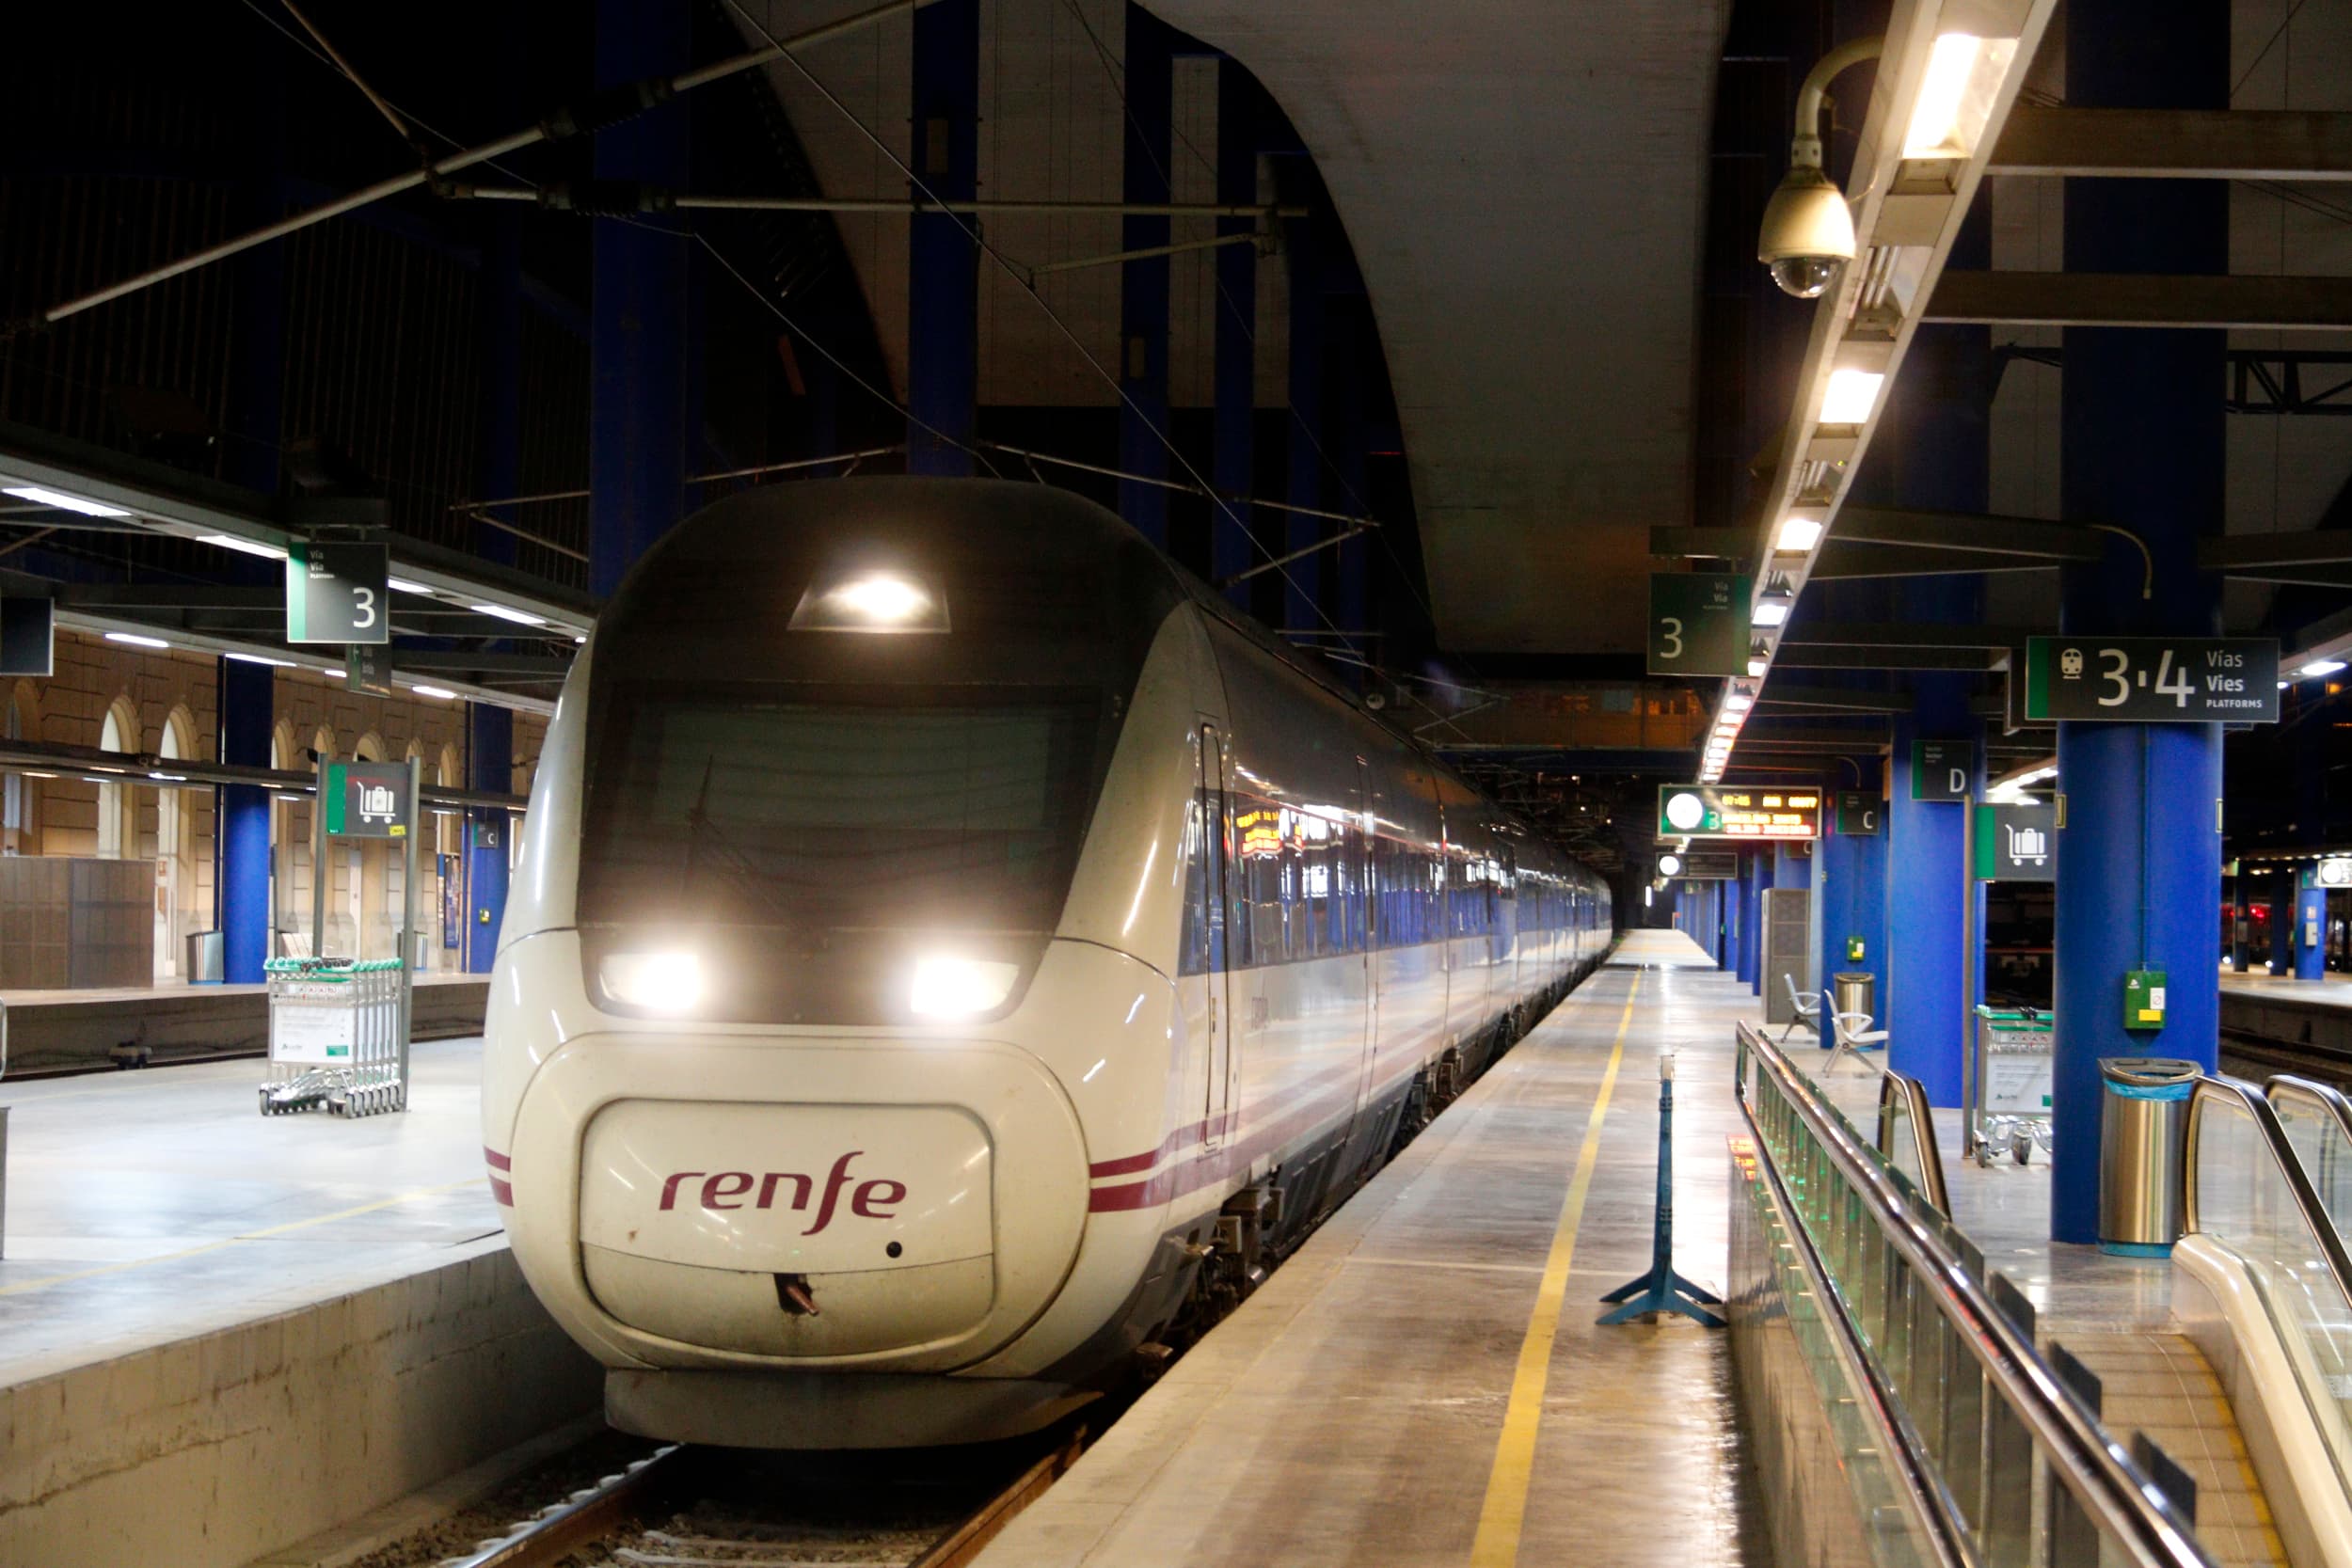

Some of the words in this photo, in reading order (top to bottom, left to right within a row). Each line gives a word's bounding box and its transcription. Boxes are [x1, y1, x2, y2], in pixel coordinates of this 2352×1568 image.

[353, 587, 375, 628] 3
[1660, 617, 1682, 658] 3
[2206, 650, 2244, 669] Vías
[2206, 675, 2245, 692] Vies
[2206, 699, 2263, 708] PLATFORMS
[1949, 768, 1966, 793] D
[1708, 811, 1721, 830] 3
[1863, 811, 1874, 829] C
[487, 832, 495, 845] C
[660, 1150, 907, 1236] renfe
